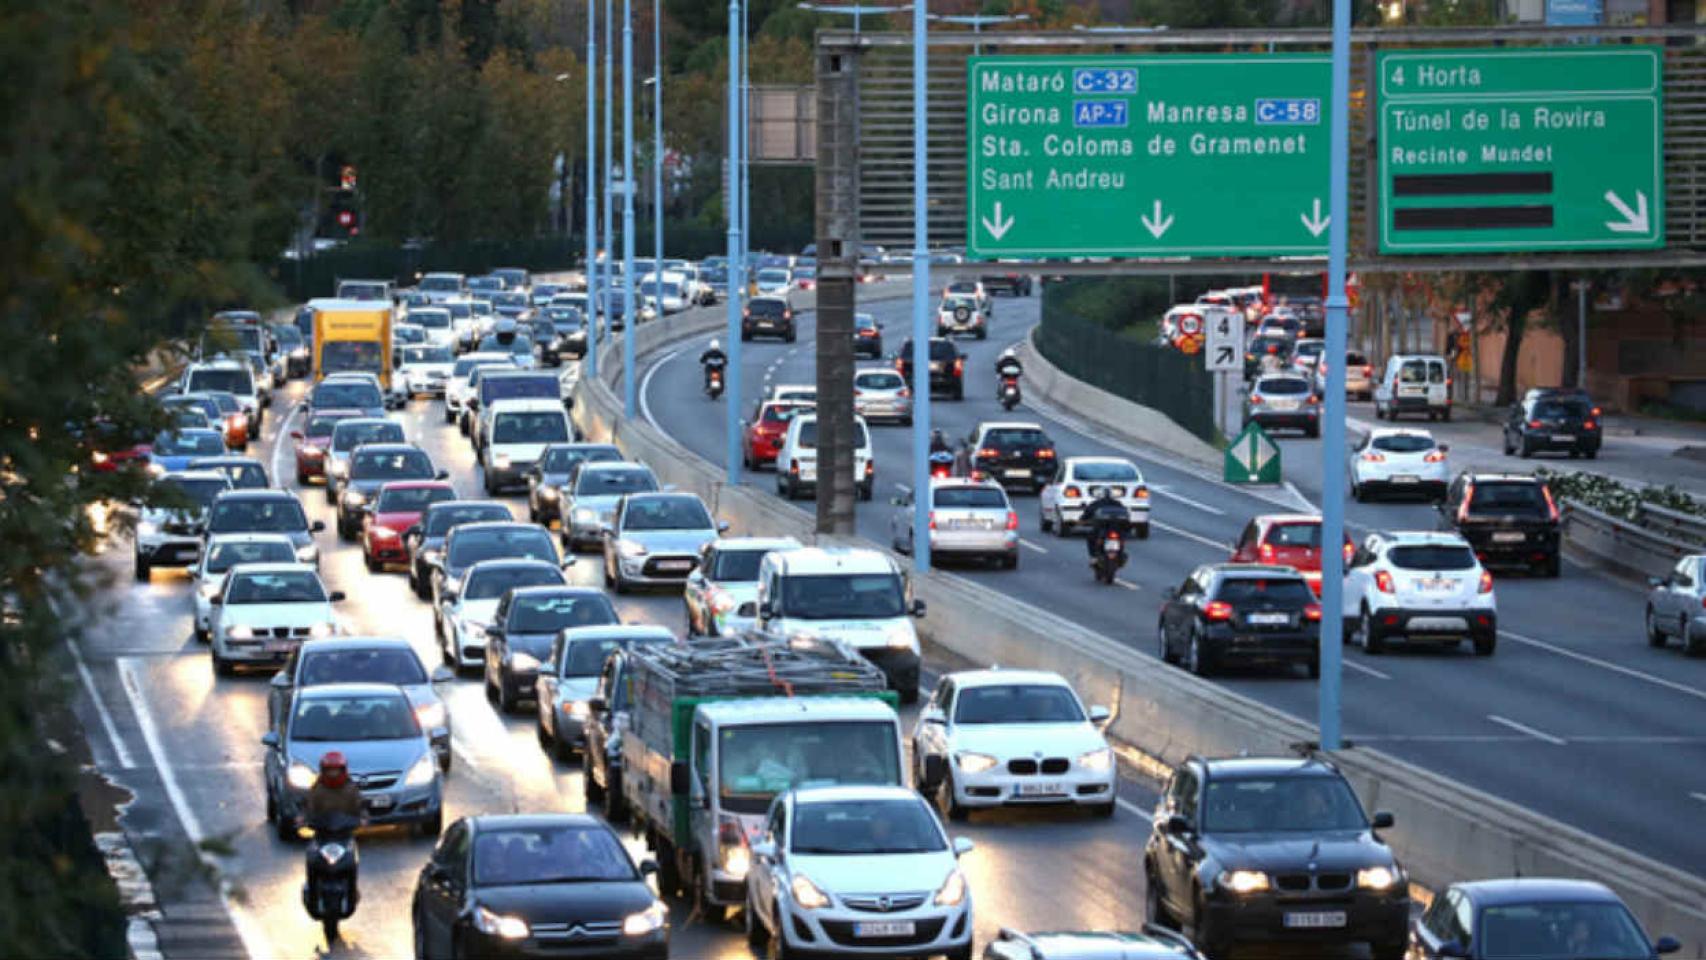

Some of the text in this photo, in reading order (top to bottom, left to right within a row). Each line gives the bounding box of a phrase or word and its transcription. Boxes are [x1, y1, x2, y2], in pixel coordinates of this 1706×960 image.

[982, 71, 1135, 92] Mataró C-32
[1391, 65, 1481, 86] 4 Horta
[982, 103, 1125, 125] Girona AP-7
[1148, 102, 1316, 123] Manresa C-58
[1392, 106, 1606, 131] Túnel de la Rovira
[982, 133, 1306, 157] Sta. Coloma de Gramenet
[1392, 145, 1553, 164] Recinte Mundet
[982, 168, 1125, 190] Sant Andreu
[1218, 317, 1229, 336] 4
